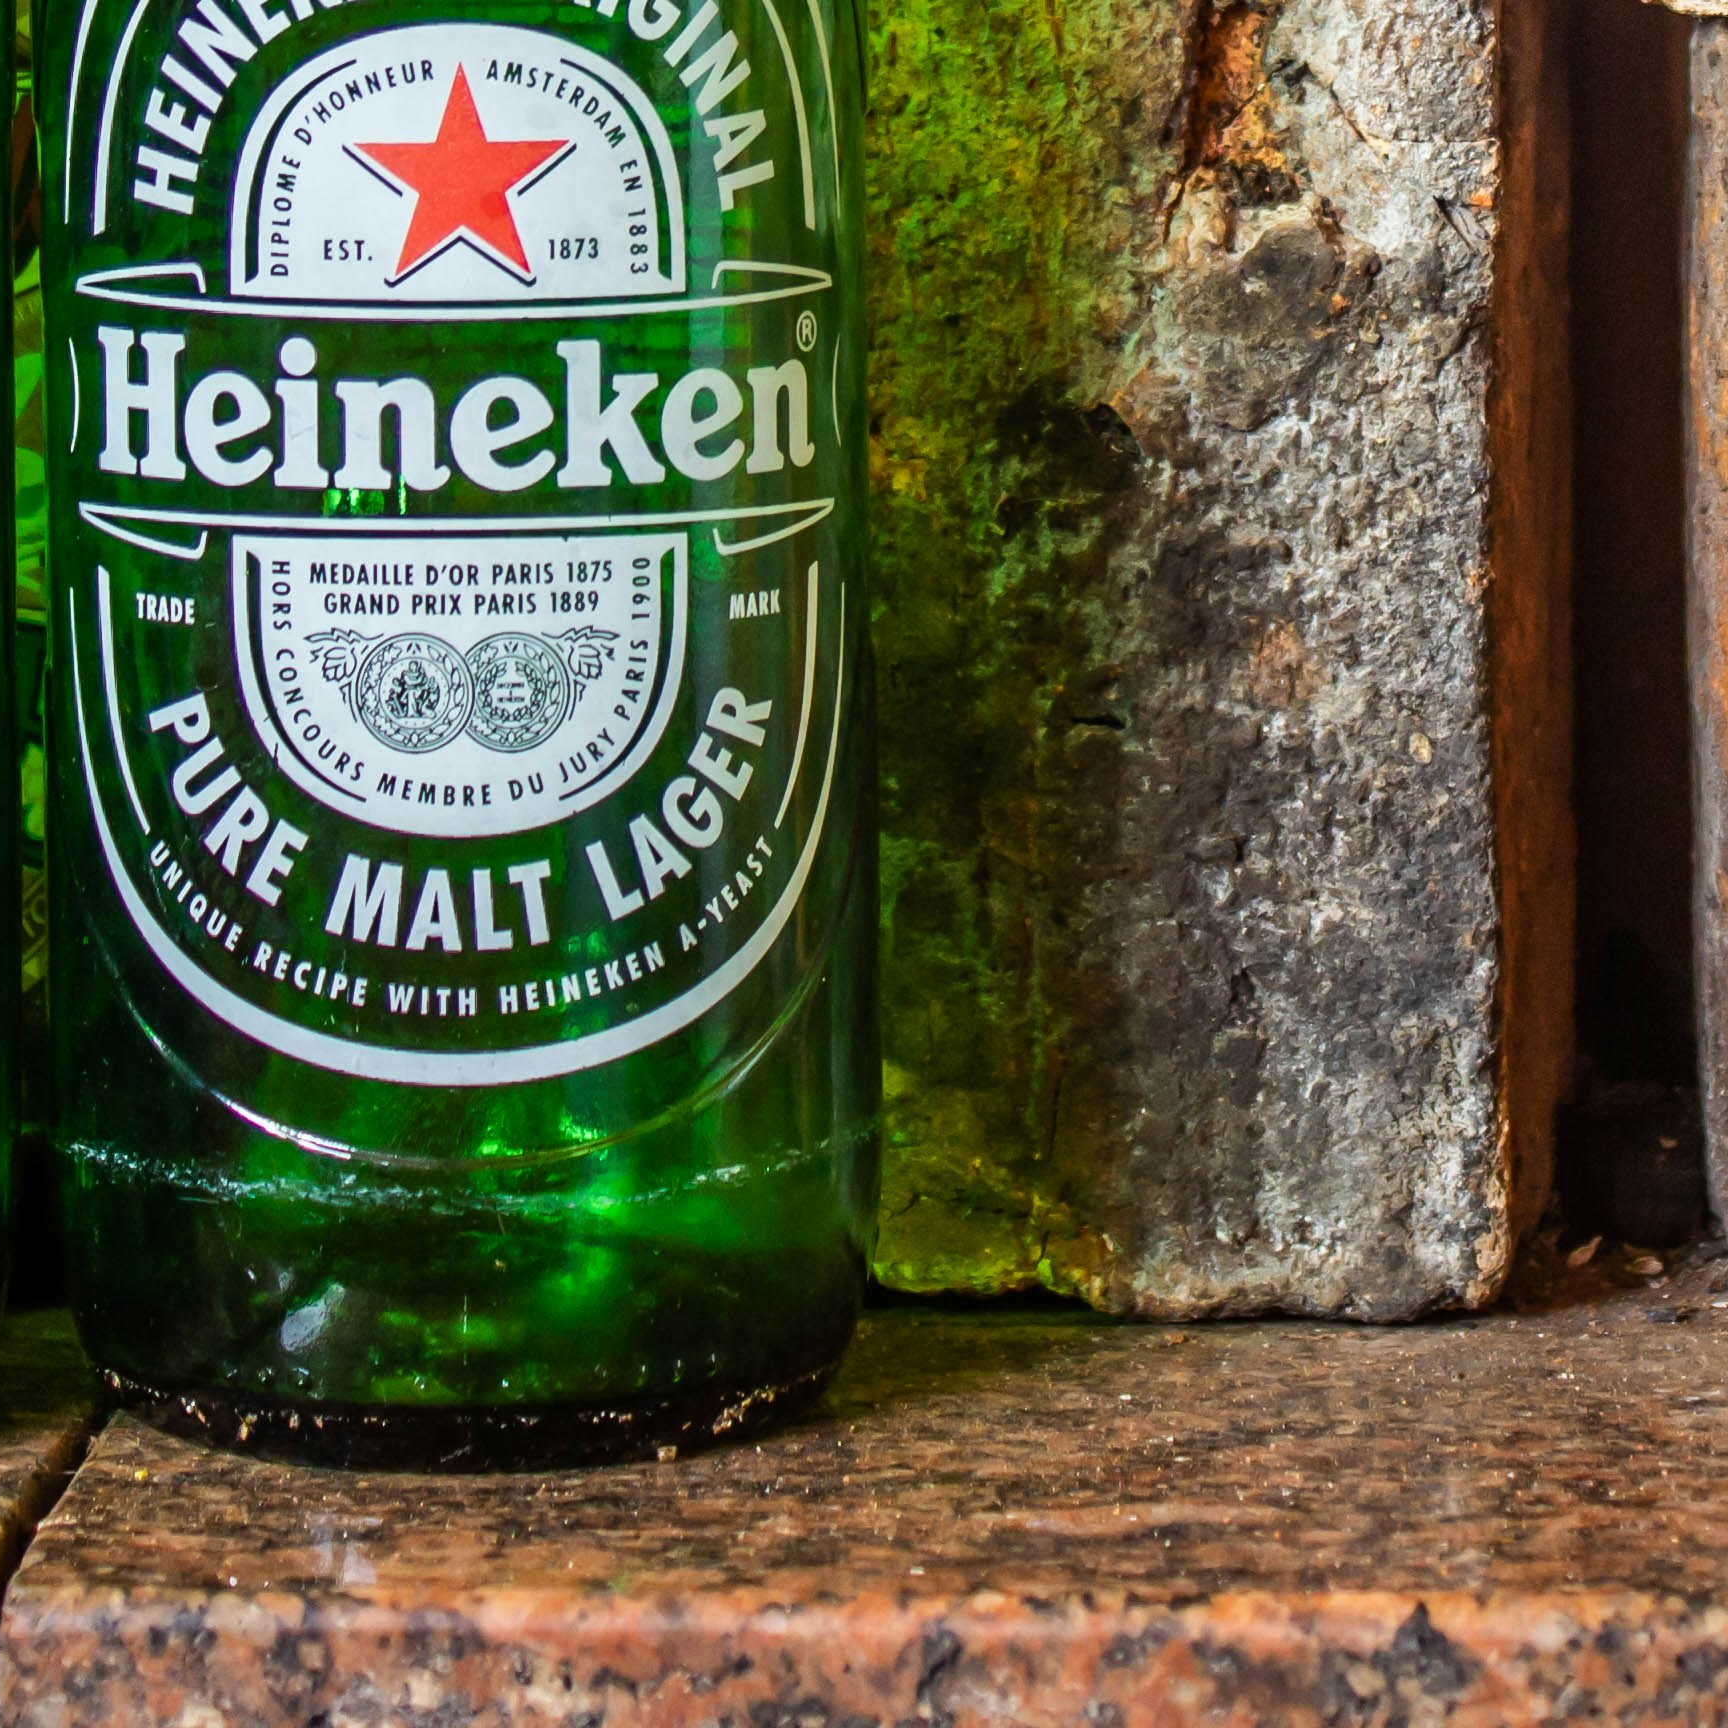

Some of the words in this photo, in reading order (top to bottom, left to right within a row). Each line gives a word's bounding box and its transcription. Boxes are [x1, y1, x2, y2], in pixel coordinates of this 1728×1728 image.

[295, 60, 433, 145] D'HONNEUR
[487, 60, 625, 148] AMSTERDAM
[620, 160, 642, 192] EN
[271, 156, 300, 276] DIPLOME
[628, 208, 648, 274] 1883
[324, 240, 372, 261] EST.
[549, 238, 598, 259] 1873
[96, 325, 815, 490] Heineken
[272, 561, 291, 630] HORS
[310, 563, 413, 585] MEDAILLE
[426, 565, 478, 585] D'OR
[493, 563, 553, 584] PARIS
[568, 560, 612, 583] 1875
[325, 593, 399, 614] GRAND
[412, 594, 461, 615] PRIX
[475, 593, 536, 614] PARIS
[551, 591, 598, 613] 1889
[632, 558, 650, 619] 1900
[730, 589, 780, 618] MARK
[136, 593, 194, 625] TRADE
[618, 640, 648, 720] PARIS
[276, 648, 366, 781] CONCOURS
[510, 773, 543, 800] DU
[560, 728, 614, 783] JURY
[149, 694, 309, 906] PURE
[326, 854, 551, 952] MALT
[586, 688, 772, 924] LAGER
[377, 773, 491, 806] MEMBRE
[151, 841, 242, 947] UNIQUE
[254, 942, 367, 1006] RECIPE
[389, 985, 477, 1016] WITH
[500, 943, 665, 1014] HEINEKEN
[680, 837, 772, 951] A-YEAST
